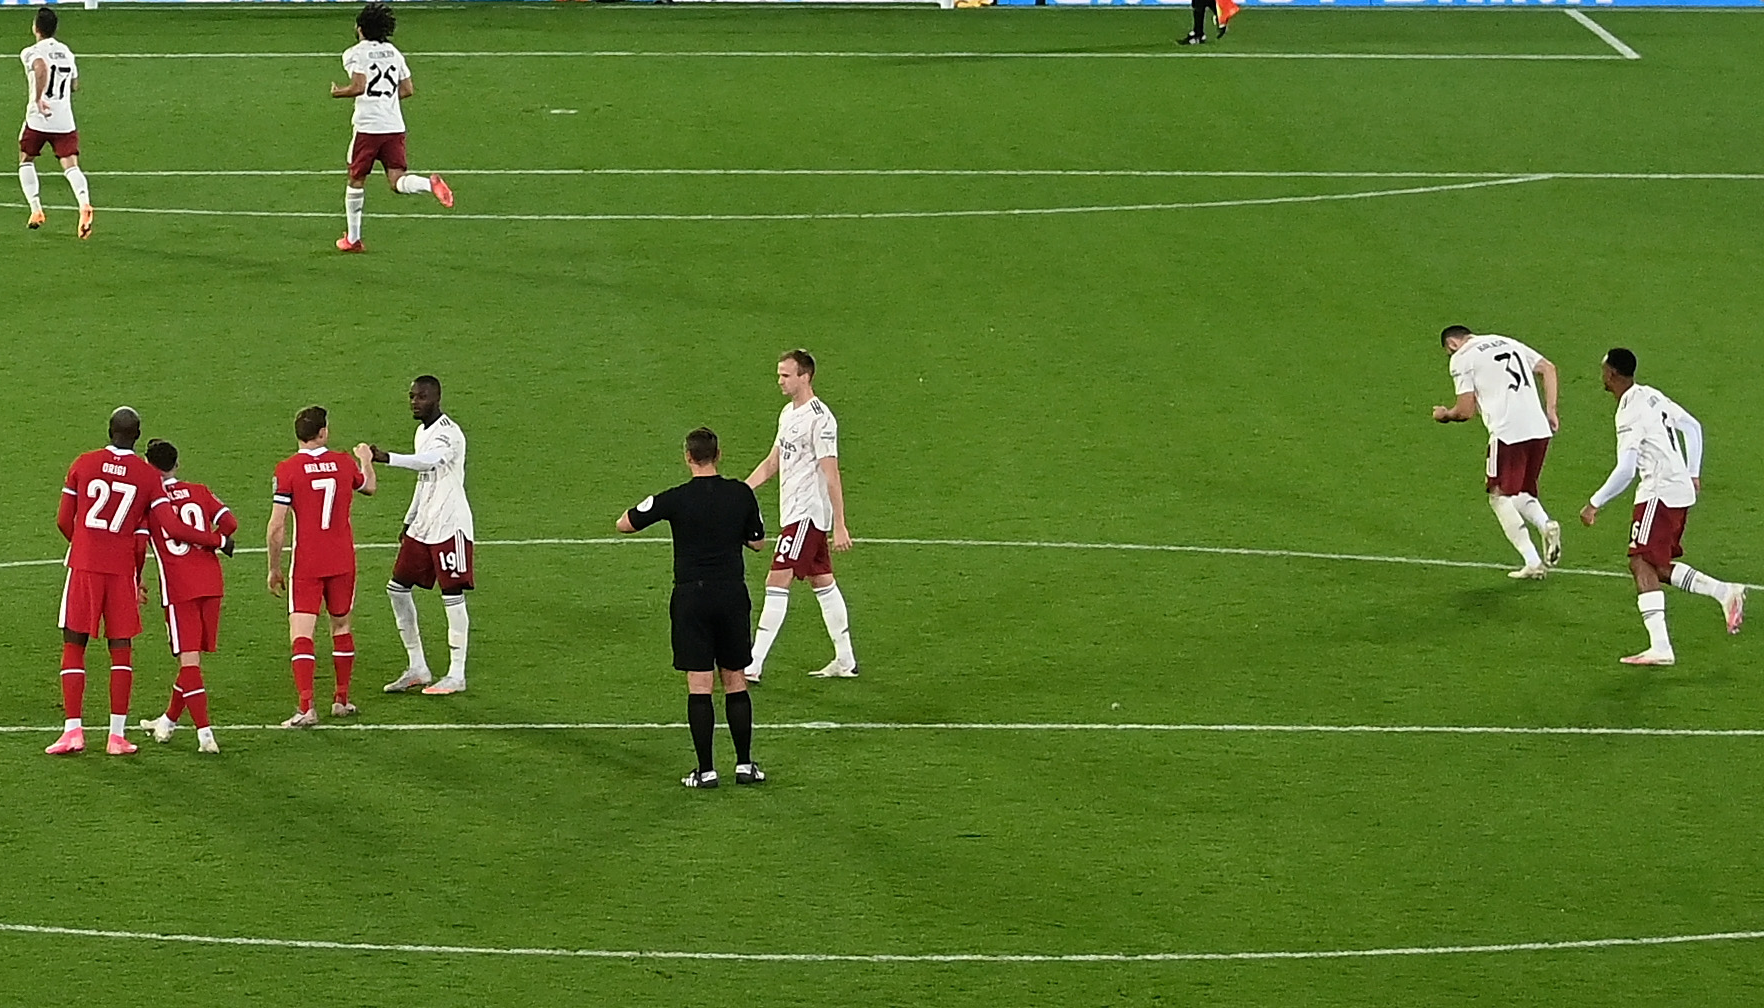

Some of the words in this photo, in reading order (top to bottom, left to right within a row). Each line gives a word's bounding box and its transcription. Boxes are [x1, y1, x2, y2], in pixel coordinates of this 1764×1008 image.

[45, 64, 72, 100] 17
[366, 62, 398, 99] 25
[1493, 350, 1532, 392] 31
[84, 478, 138, 533] 27
[310, 477, 337, 531] 7
[438, 551, 457, 571] 19
